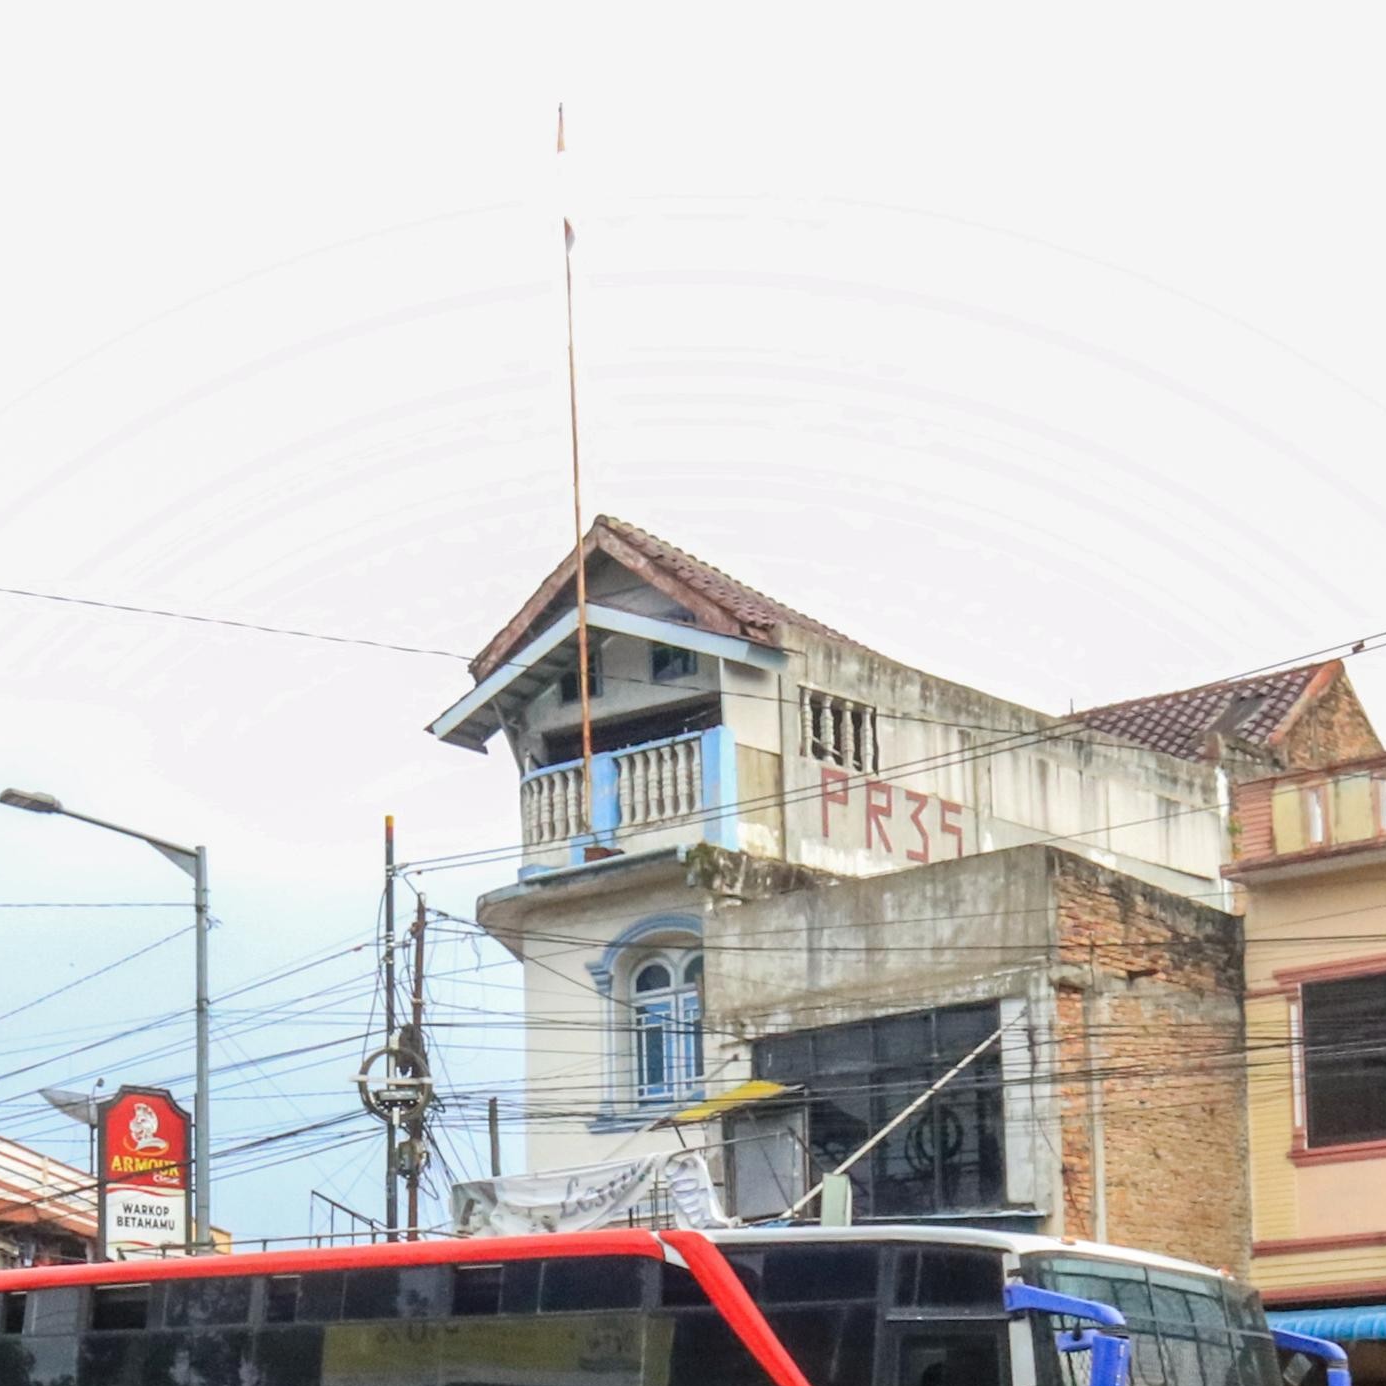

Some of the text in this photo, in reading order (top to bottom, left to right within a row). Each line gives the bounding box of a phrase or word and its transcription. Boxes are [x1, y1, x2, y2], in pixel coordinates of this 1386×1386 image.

[111, 1154, 180, 1178] ARMOUR
[122, 1202, 170, 1218] WARKOP
[116, 1215, 175, 1231] BETAHAMU
